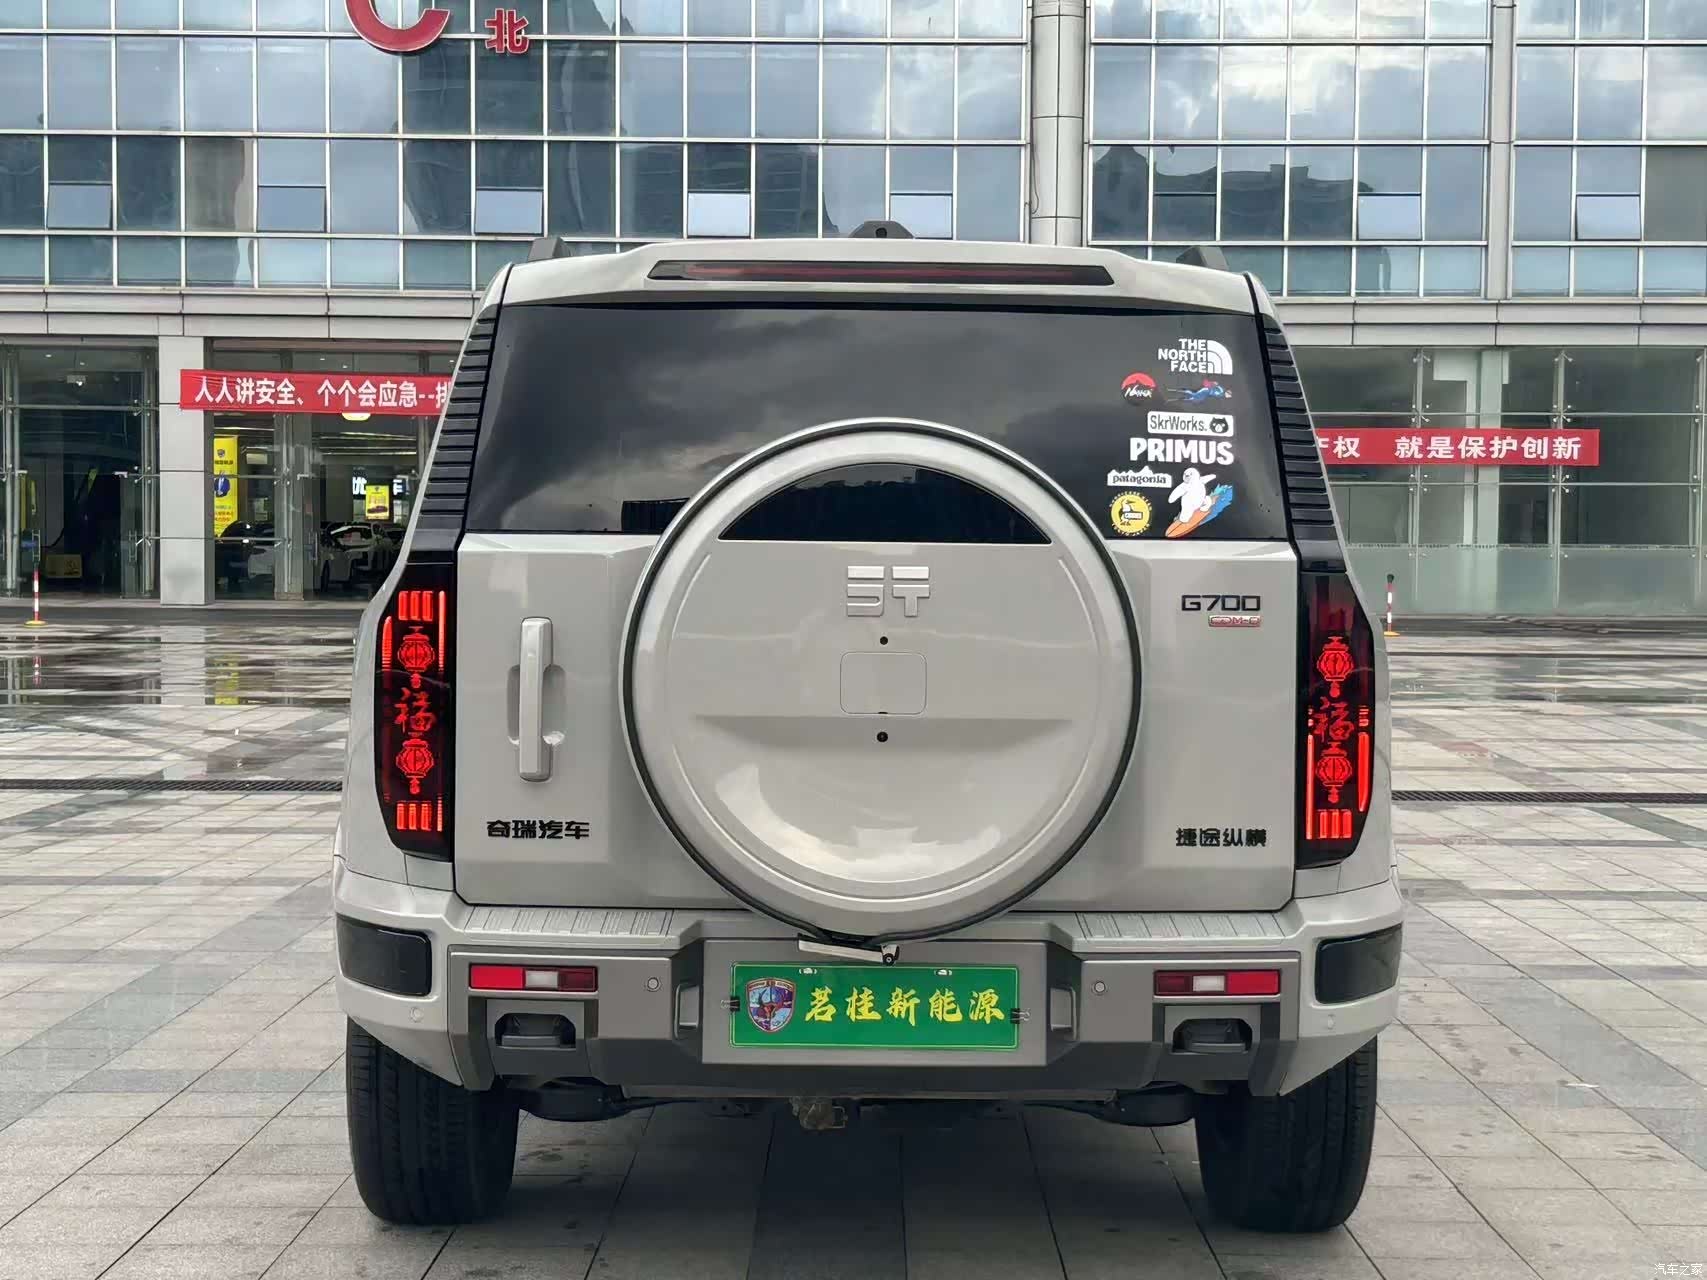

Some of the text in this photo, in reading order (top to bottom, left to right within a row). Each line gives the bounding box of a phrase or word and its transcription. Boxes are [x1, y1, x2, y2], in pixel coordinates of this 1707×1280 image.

[484, 7, 530, 54] 北
[1178, 338, 1206, 351] THE
[1157, 348, 1207, 362] NORTH
[1170, 360, 1208, 373] FACE
[1149, 413, 1208, 432] SkrWorks.
[1129, 437, 1235, 466] PRIMUS
[1394, 435, 1582, 460] 就是保护创新
[1112, 473, 1167, 485] patagonia
[1181, 594, 1261, 611] G700
[394, 687, 435, 733] 福
[486, 819, 590, 840] 奇瑞汽车
[1175, 827, 1267, 847] 捷途纵横
